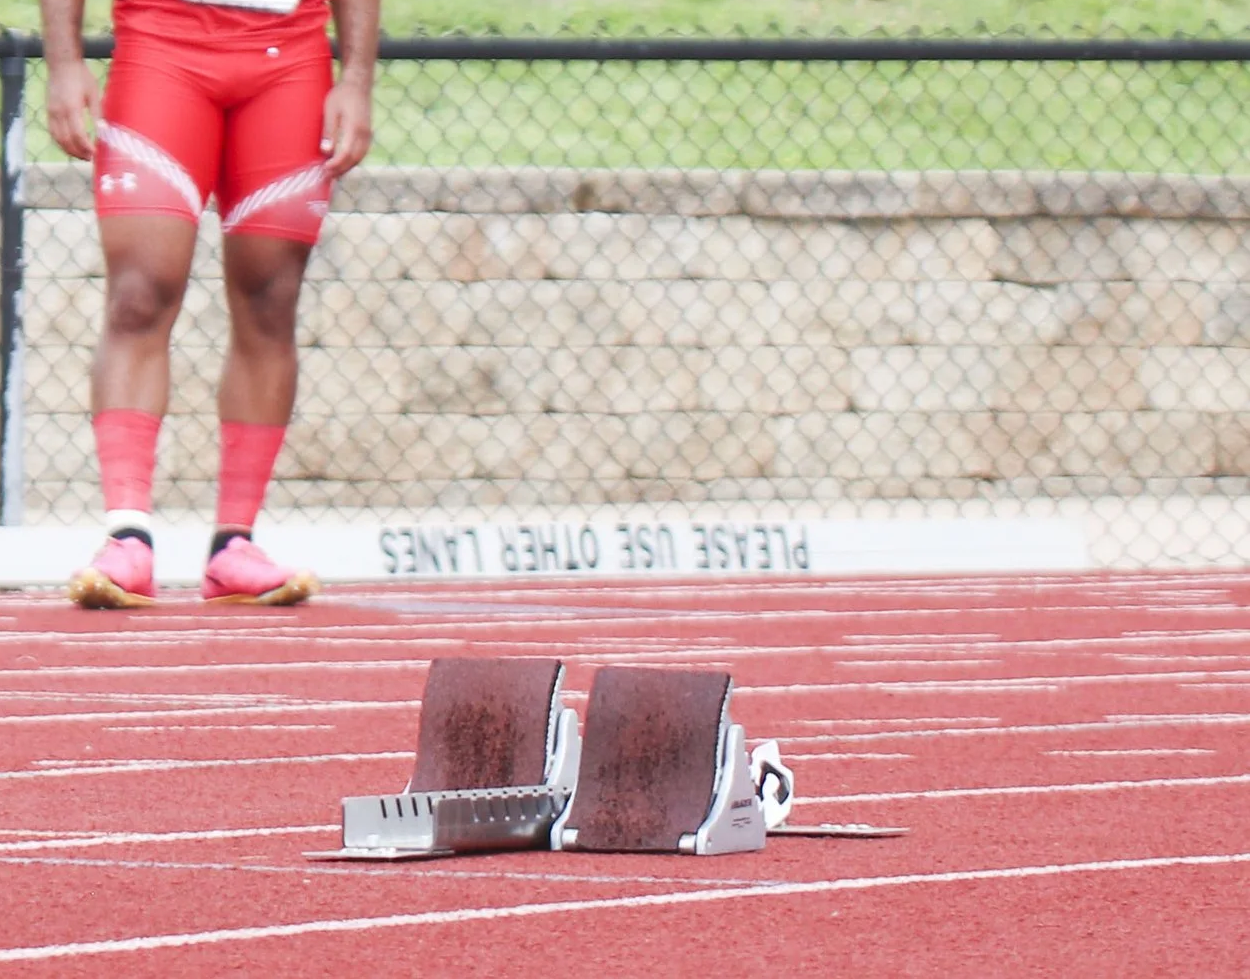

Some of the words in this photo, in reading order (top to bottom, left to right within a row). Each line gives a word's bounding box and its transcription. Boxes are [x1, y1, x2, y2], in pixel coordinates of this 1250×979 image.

[379, 526, 483, 573] LANES
[498, 524, 599, 570] OTHER
[616, 524, 677, 570] USE
[693, 525, 810, 570] PLEASE
